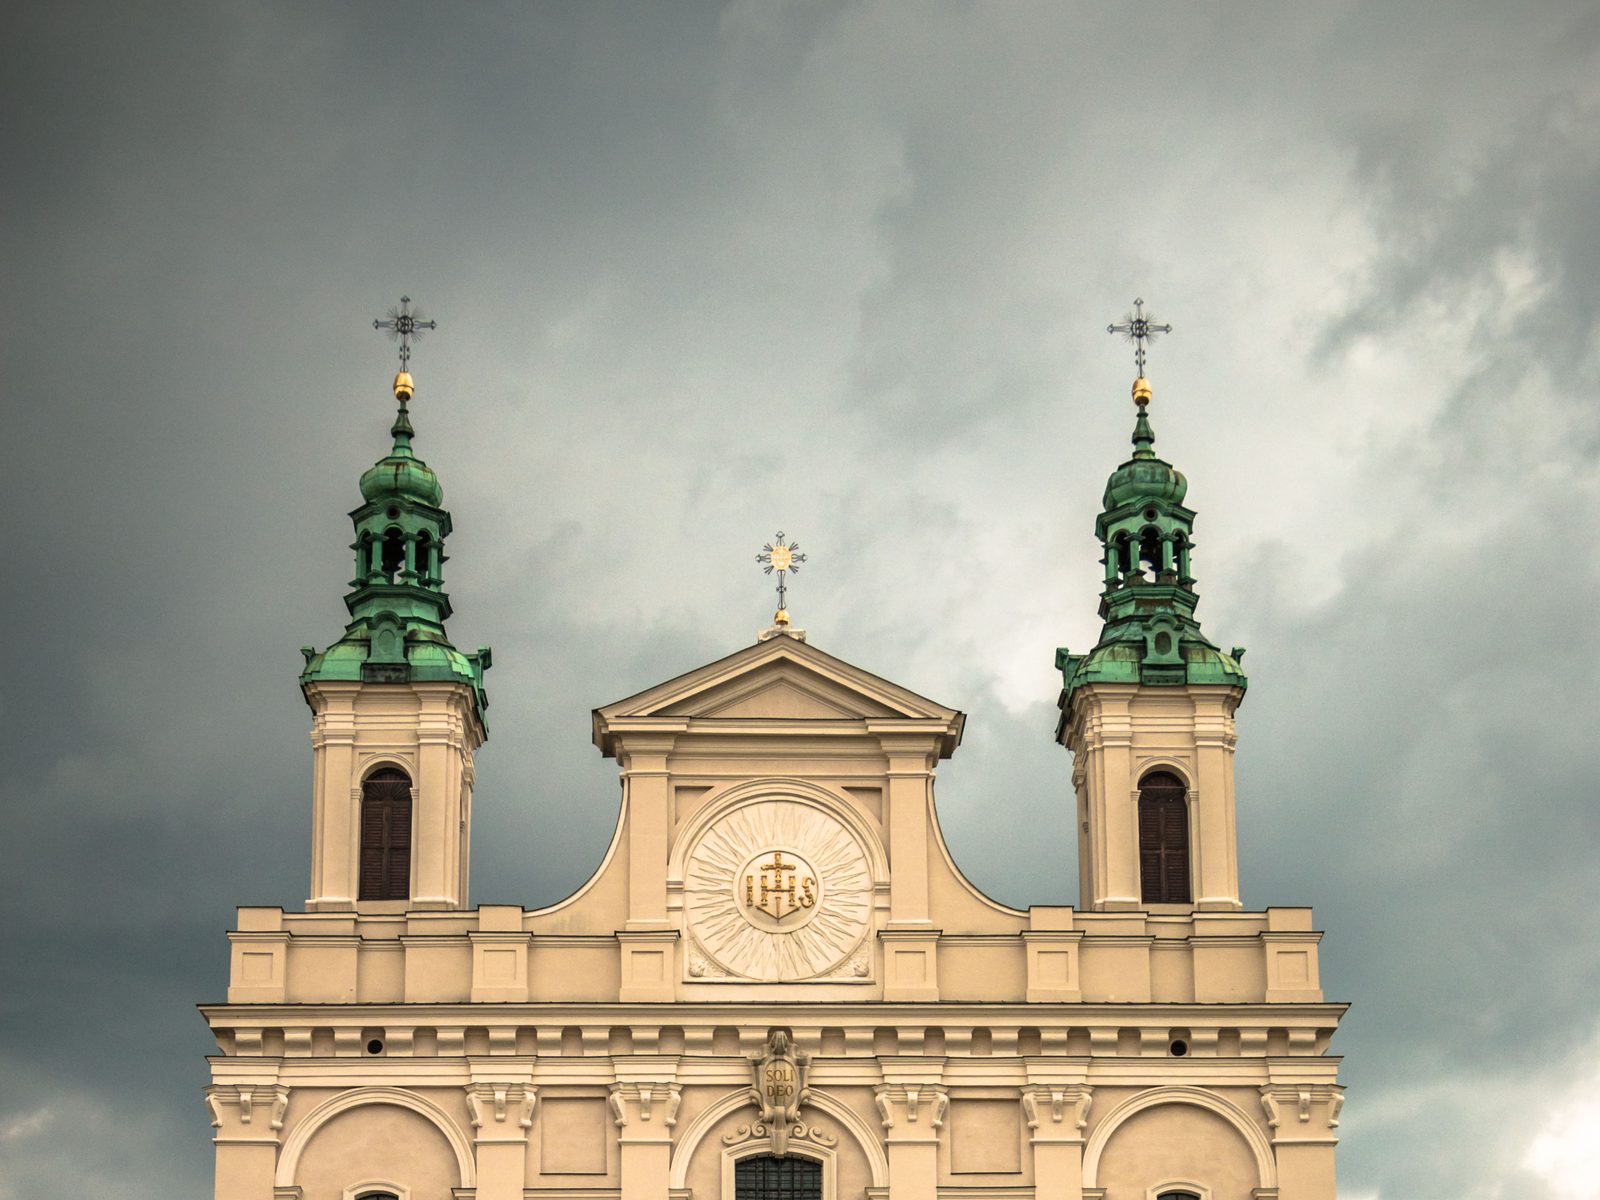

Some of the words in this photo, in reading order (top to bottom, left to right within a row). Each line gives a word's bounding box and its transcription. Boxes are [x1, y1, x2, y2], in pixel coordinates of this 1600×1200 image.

[746, 876, 815, 909] IHS
[766, 1069, 794, 1082] SOLI
[766, 1085, 794, 1097] DEO
